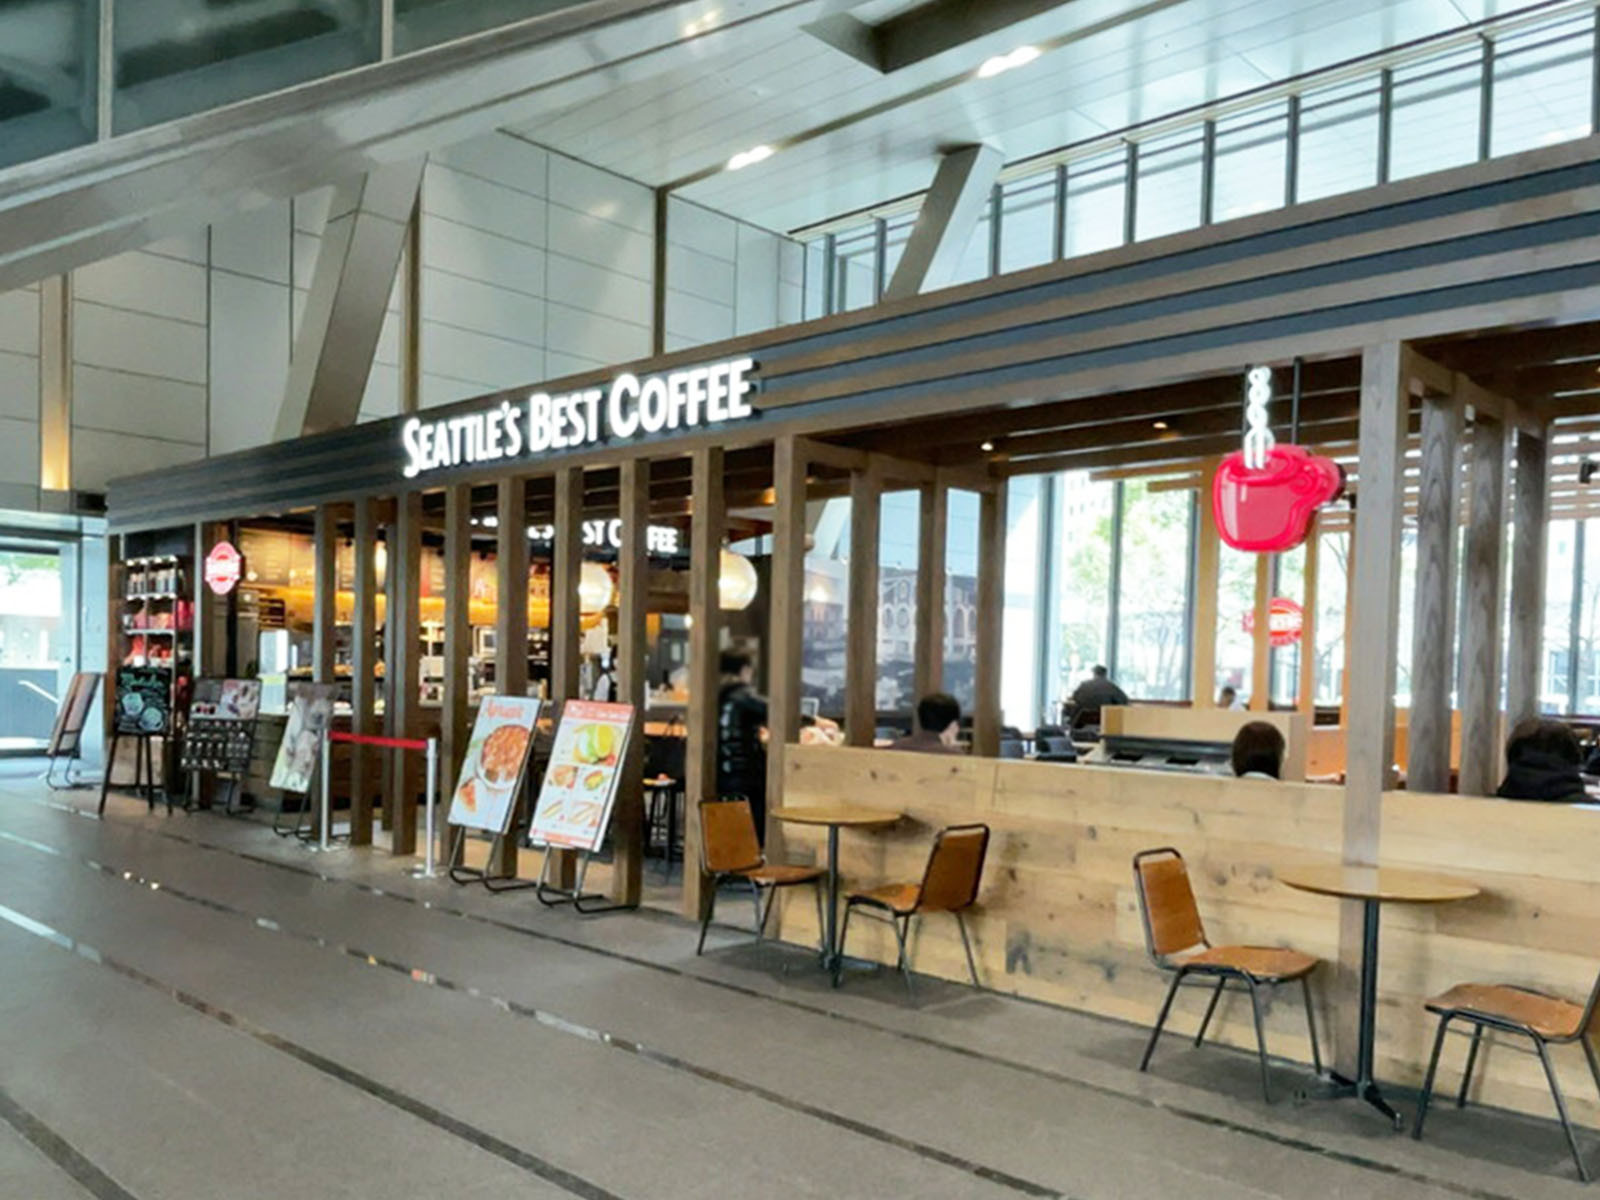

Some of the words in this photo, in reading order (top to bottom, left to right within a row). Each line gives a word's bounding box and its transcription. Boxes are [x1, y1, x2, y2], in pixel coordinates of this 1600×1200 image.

[402, 400, 522, 478] SEATTLE'S
[528, 390, 603, 453] BEST
[608, 357, 754, 439] COFFEE
